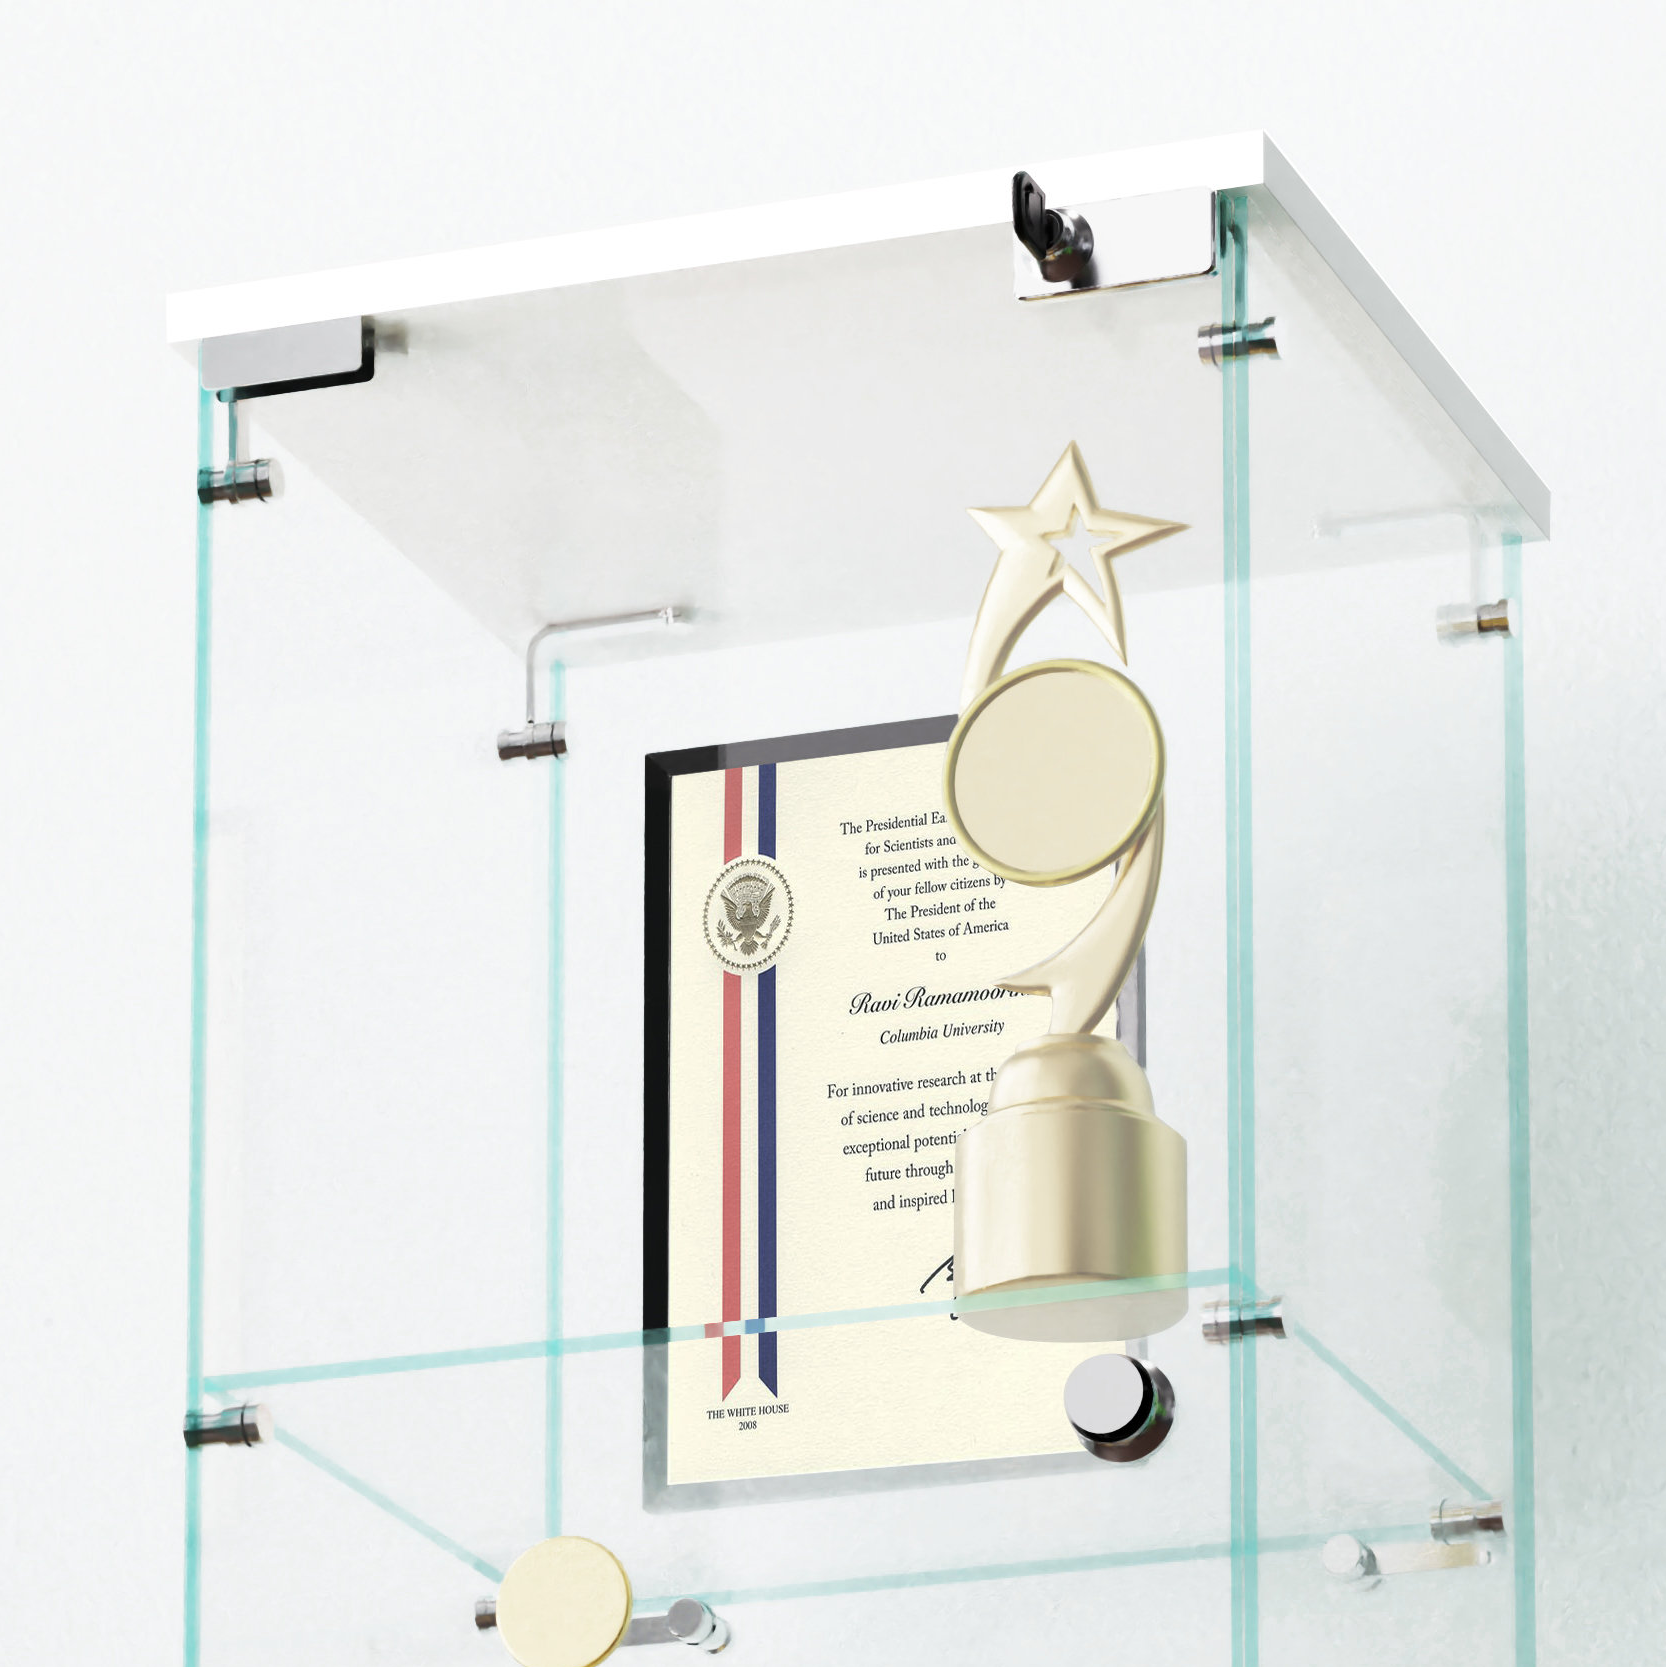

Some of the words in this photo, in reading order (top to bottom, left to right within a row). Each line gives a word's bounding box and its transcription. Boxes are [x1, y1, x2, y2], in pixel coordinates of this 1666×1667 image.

[840, 821, 863, 835] The
[865, 813, 928, 833] Presidential
[865, 842, 880, 855] for
[883, 837, 933, 853] Scientists
[859, 867, 868, 878] is
[870, 859, 921, 881] presented
[924, 855, 948, 870] with
[952, 854, 969, 867] the
[873, 887, 884, 899] of
[887, 886, 912, 902] your
[915, 880, 947, 895] fellow
[950, 875, 990, 891] citizens
[994, 873, 1006, 888] by
[884, 907, 907, 921] The
[910, 902, 960, 918] President
[964, 898, 976, 912] of
[978, 897, 996, 910] the
[873, 928, 910, 945] United
[913, 926, 945, 941] States
[948, 922, 961, 936] of
[963, 918, 1009, 935] America
[935, 951, 947, 961] to
[849, 991, 901, 1015] Ravi
[903, 985, 1030, 1009] Ramamoor
[880, 1026, 938, 1045] Columbia
[942, 1018, 1005, 1038] University
[827, 1083, 849, 1099] For
[852, 1078, 914, 1096] innovative
[917, 1070, 966, 1089] research
[970, 1072, 982, 1083] at
[985, 1067, 997, 1082] th
[841, 1111, 855, 1126] of
[857, 1110, 899, 1124] science
[902, 1103, 925, 1119] and
[929, 1098, 989, 1117] technolog
[843, 1134, 910, 1157] exceptional
[914, 1128, 967, 1153] potenti
[865, 1166, 901, 1182] future
[905, 1160, 954, 1180] through
[873, 1194, 896, 1211] and
[899, 1188, 948, 1211] inspired
[707, 1410, 725, 1420] THE
[727, 1406, 757, 1418] WHITE
[758, 1403, 790, 1415] HOUSE
[738, 1420, 758, 1431] 2008
